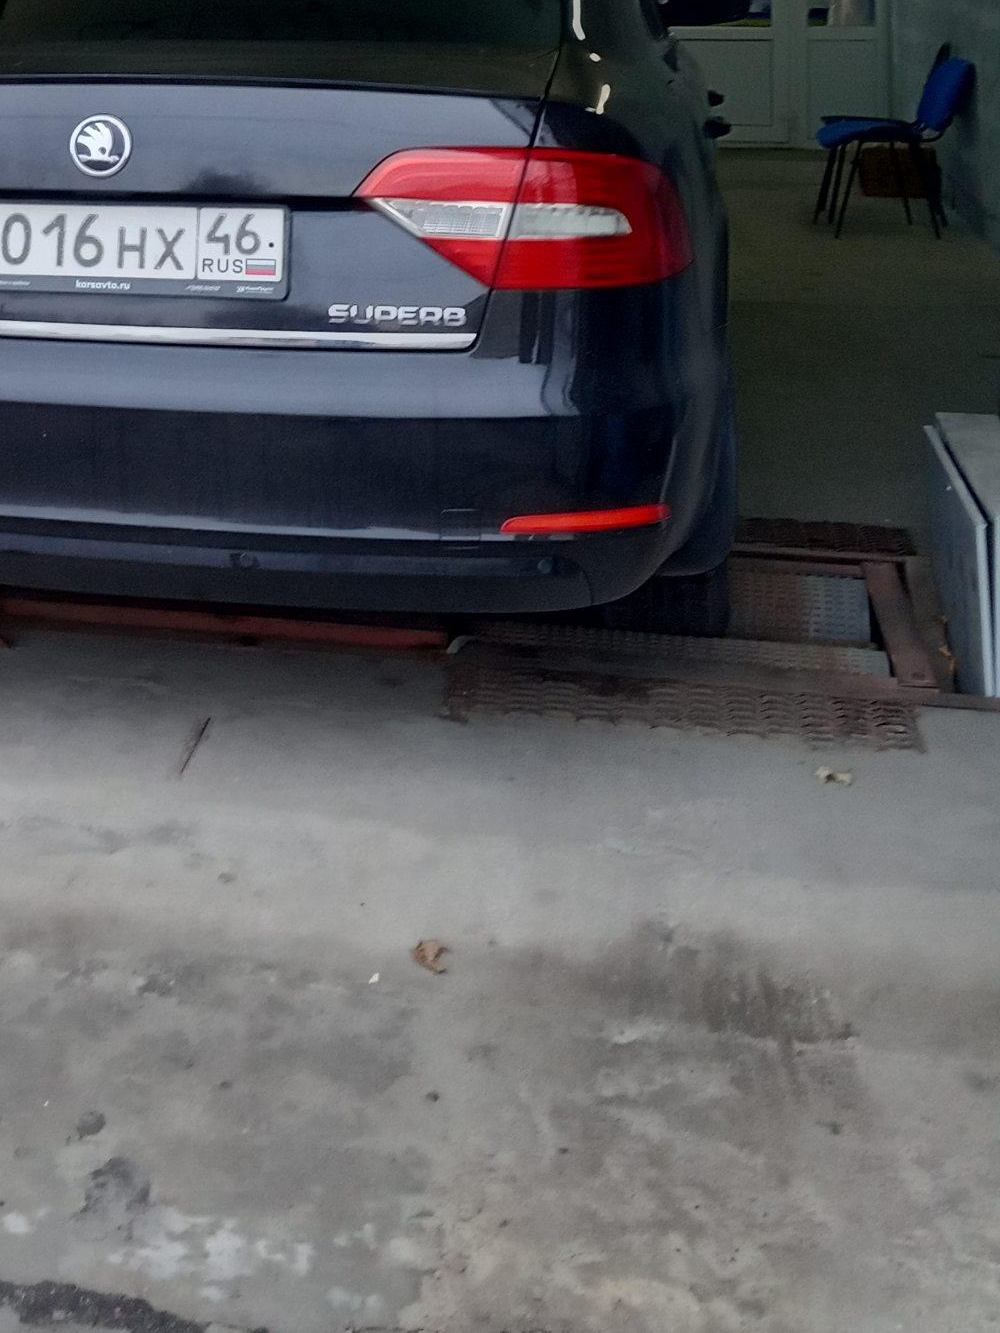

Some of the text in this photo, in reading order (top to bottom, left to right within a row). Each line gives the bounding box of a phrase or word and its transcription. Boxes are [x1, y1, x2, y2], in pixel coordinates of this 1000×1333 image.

[204, 213, 261, 256] 46
[201, 258, 244, 274] RUS
[75, 279, 131, 290] korsavto.ru
[328, 303, 467, 327] SUPERB
